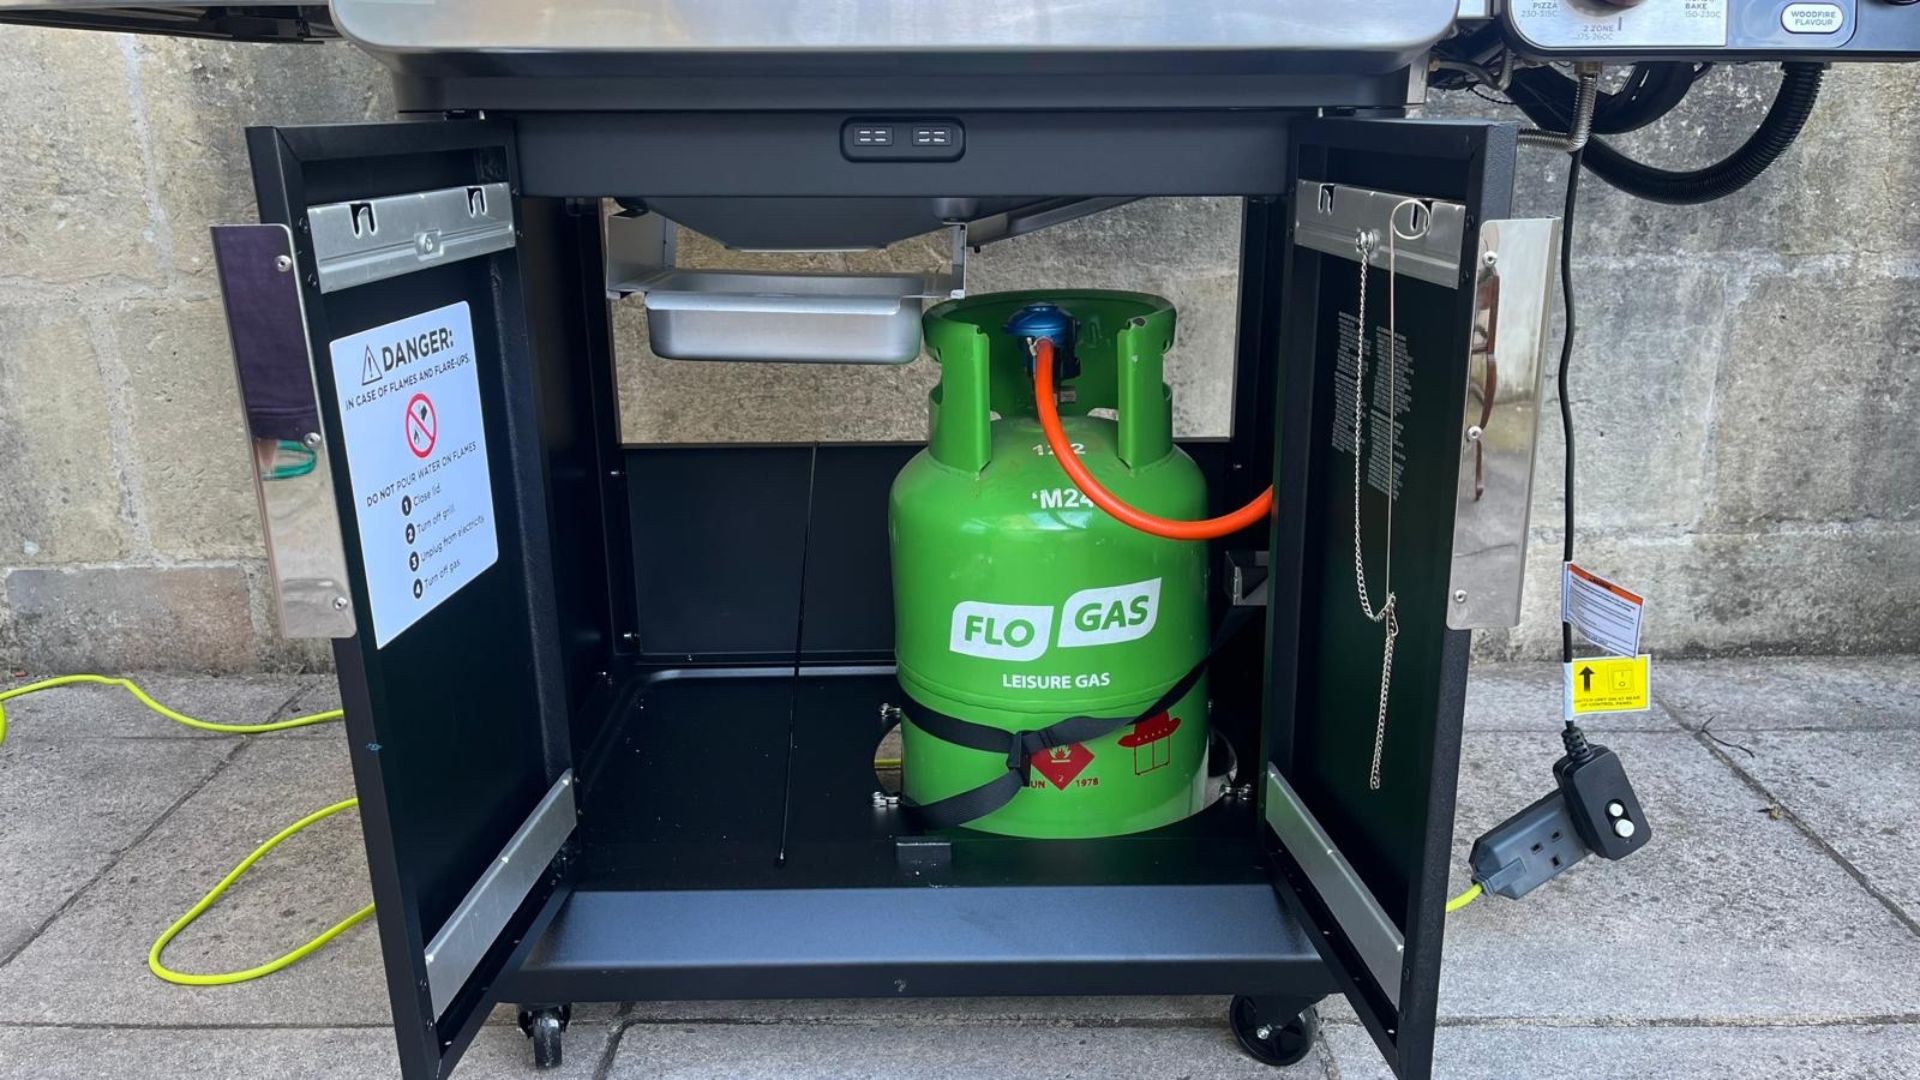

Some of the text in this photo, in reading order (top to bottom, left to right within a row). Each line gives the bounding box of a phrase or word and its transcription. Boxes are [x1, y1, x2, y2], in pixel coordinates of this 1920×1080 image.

[1590, 24, 1614, 32] ZONE
[382, 327, 454, 372] DANGER:
[345, 397, 355, 411] IN
[356, 390, 377, 407] CASE
[379, 385, 388, 398] OF
[389, 374, 418, 393] FLAMES
[419, 368, 434, 381] AND
[366, 441, 477, 507] DO NOT POUR WATER ON FLAMES
[413, 490, 431, 506] Close
[417, 519, 432, 534] Turn
[432, 511, 441, 525] off
[420, 542, 443, 562] Unplug
[424, 574, 439, 589] Turn
[964, 595, 1149, 647] FLO GAS
[1003, 672, 1110, 689] LEISURE GAS
[1030, 778, 1099, 789] UN 1978
